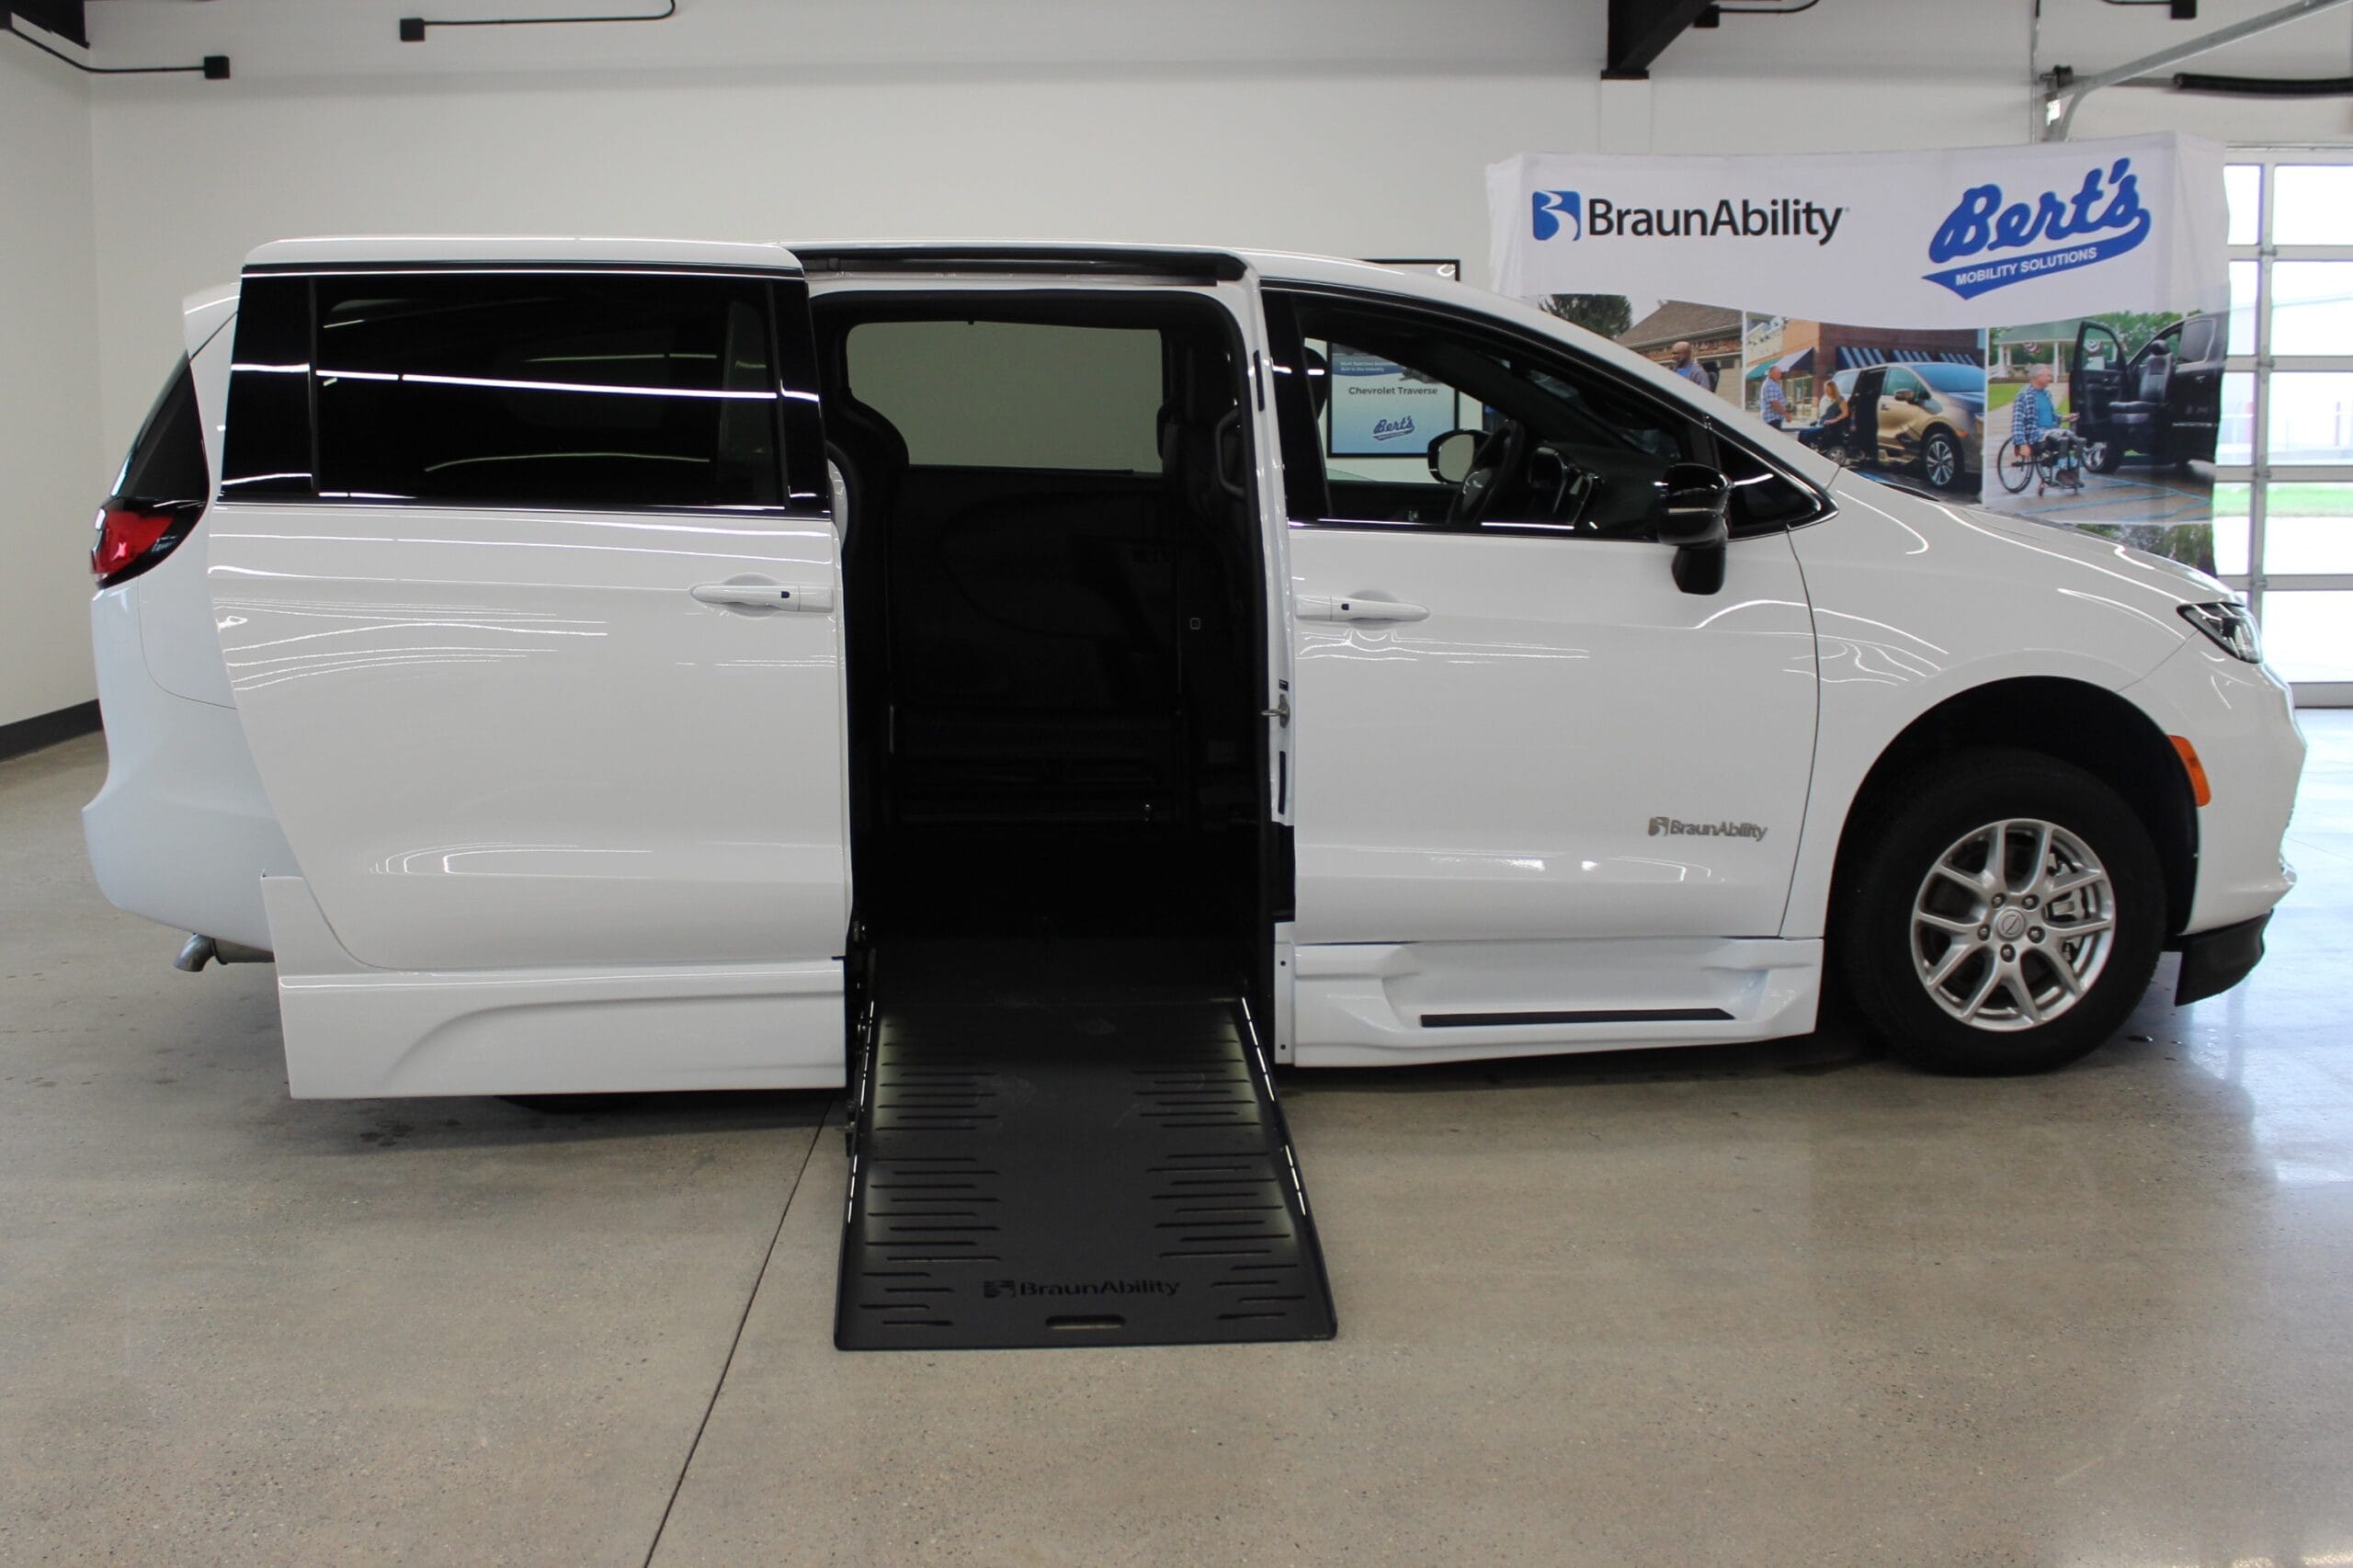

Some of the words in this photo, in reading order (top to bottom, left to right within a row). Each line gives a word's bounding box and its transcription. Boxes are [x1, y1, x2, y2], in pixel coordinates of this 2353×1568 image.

[1587, 197, 1844, 246] BraunAbility
[1927, 157, 2141, 265] Bert's
[1955, 263, 2018, 286] MOBILITY
[2019, 246, 2097, 273] SOLUTIONS
[1347, 386, 1395, 395] Chevrolet
[1397, 386, 1438, 395] Traverse
[1372, 415, 1415, 435] Bert's
[1669, 819, 1768, 843] BraunAbility
[1019, 1279, 1182, 1298] BraunAbility
